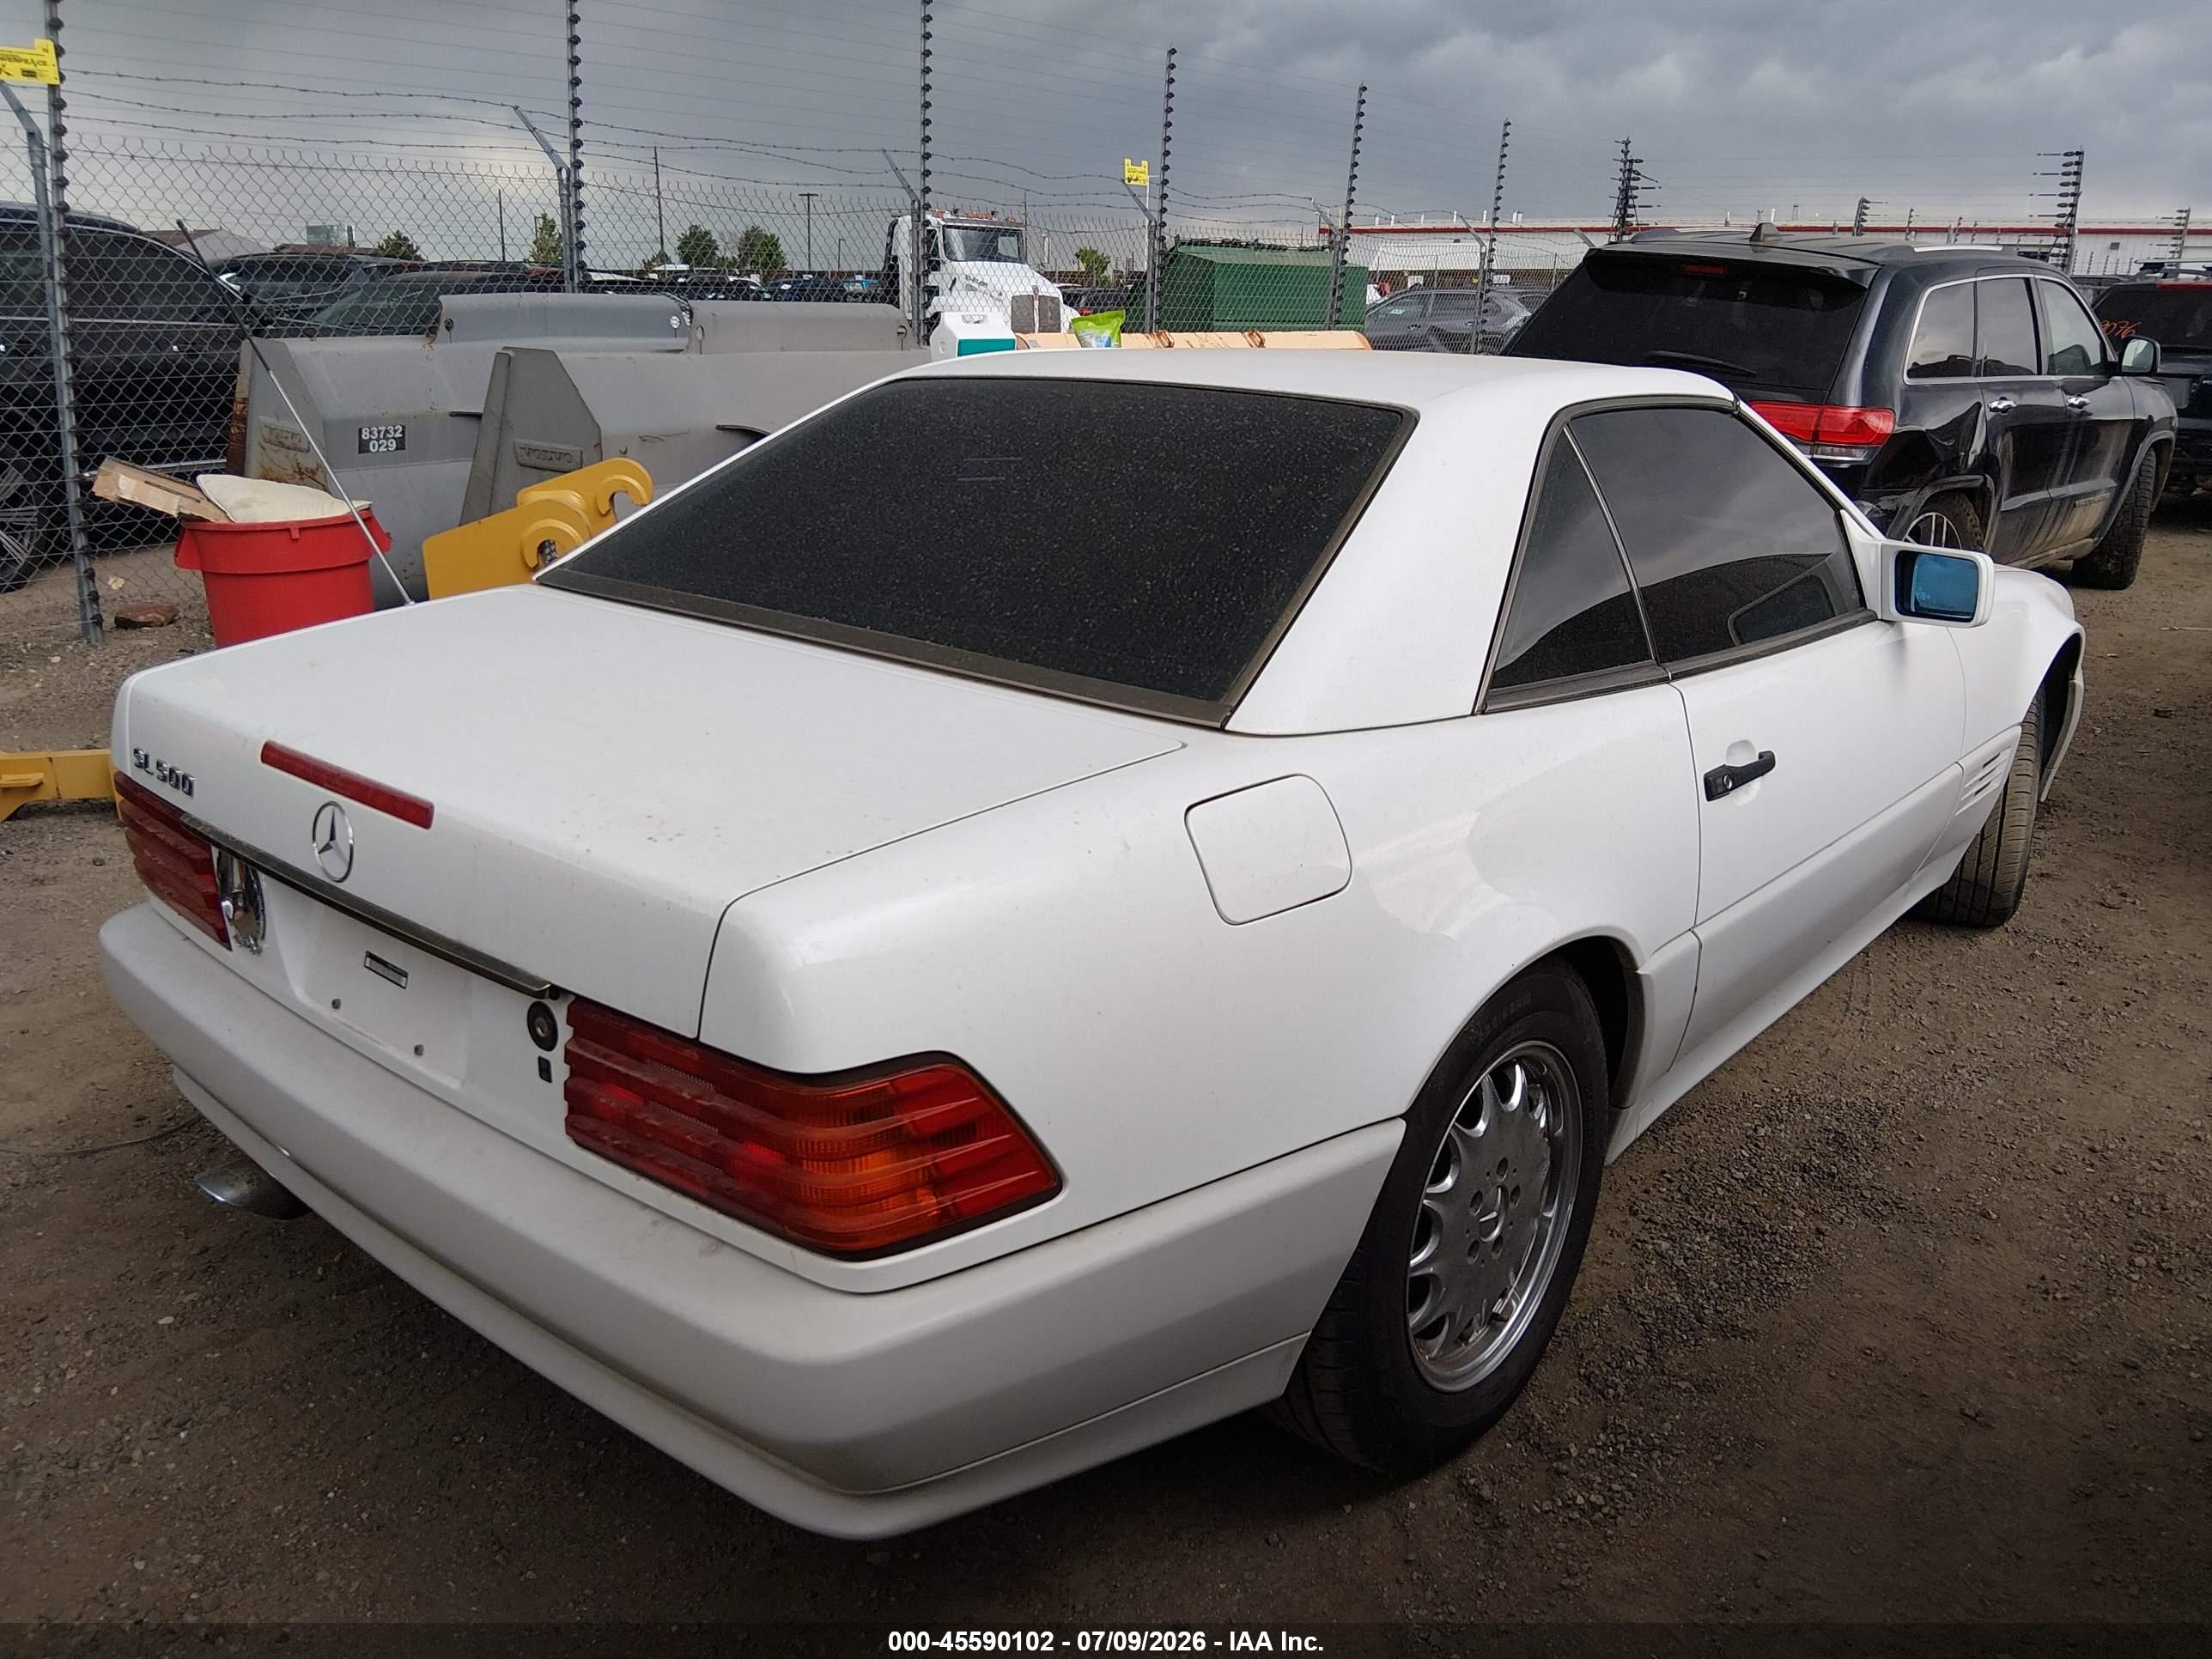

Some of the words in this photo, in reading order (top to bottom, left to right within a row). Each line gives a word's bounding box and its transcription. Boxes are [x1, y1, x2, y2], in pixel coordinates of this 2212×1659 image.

[362, 425, 403, 440] 83732
[369, 439, 397, 453] 029
[519, 446, 574, 464] VOLVO
[133, 748, 155, 775] SL
[156, 759, 196, 798] 500
